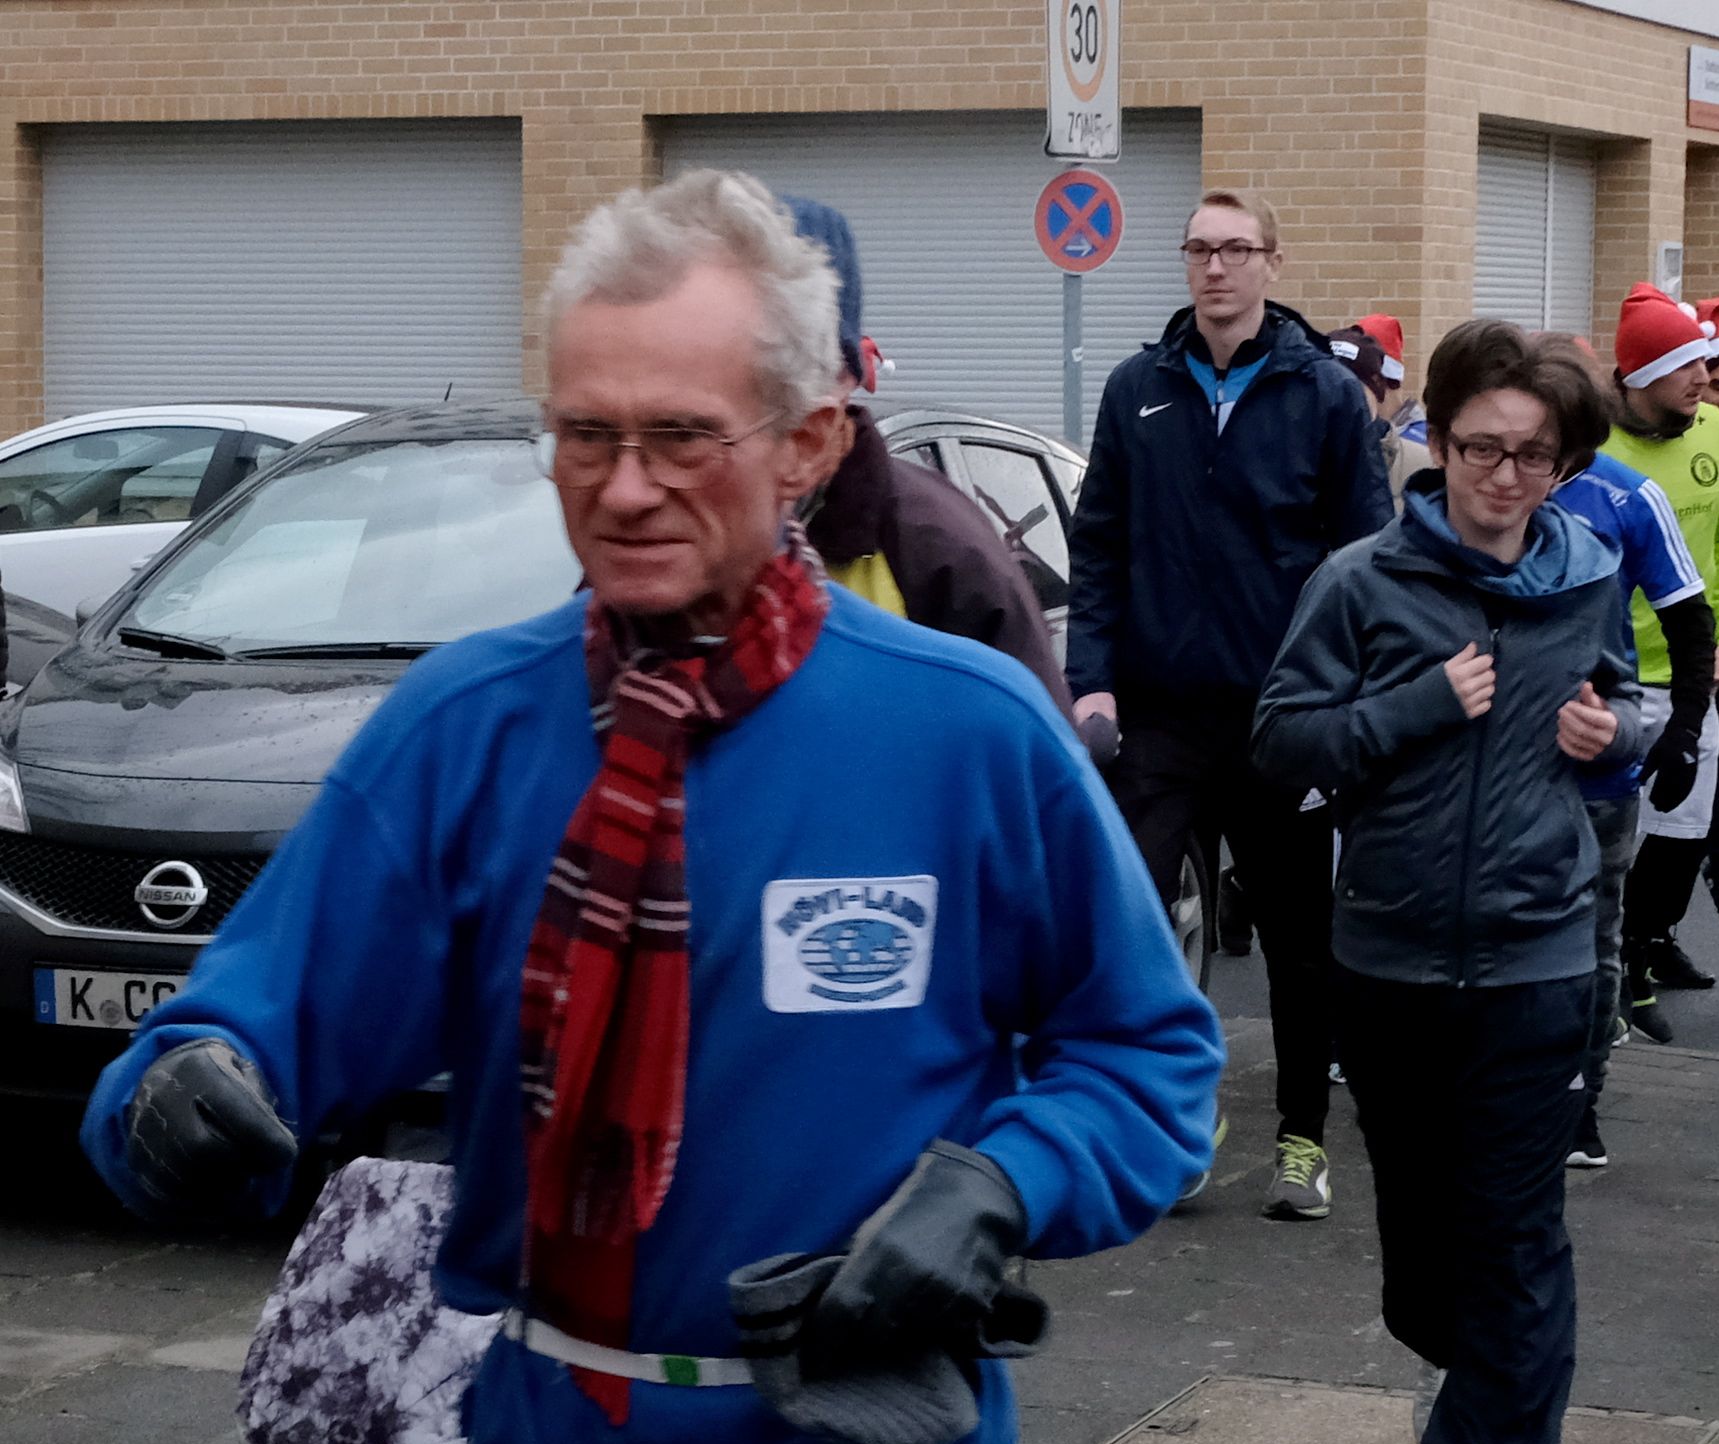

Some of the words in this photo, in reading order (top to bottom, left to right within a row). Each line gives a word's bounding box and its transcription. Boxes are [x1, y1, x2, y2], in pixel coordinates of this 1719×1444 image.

[1070, 3, 1098, 64] 30
[138, 888, 197, 902] NISSAN
[69, 976, 95, 1021] K
